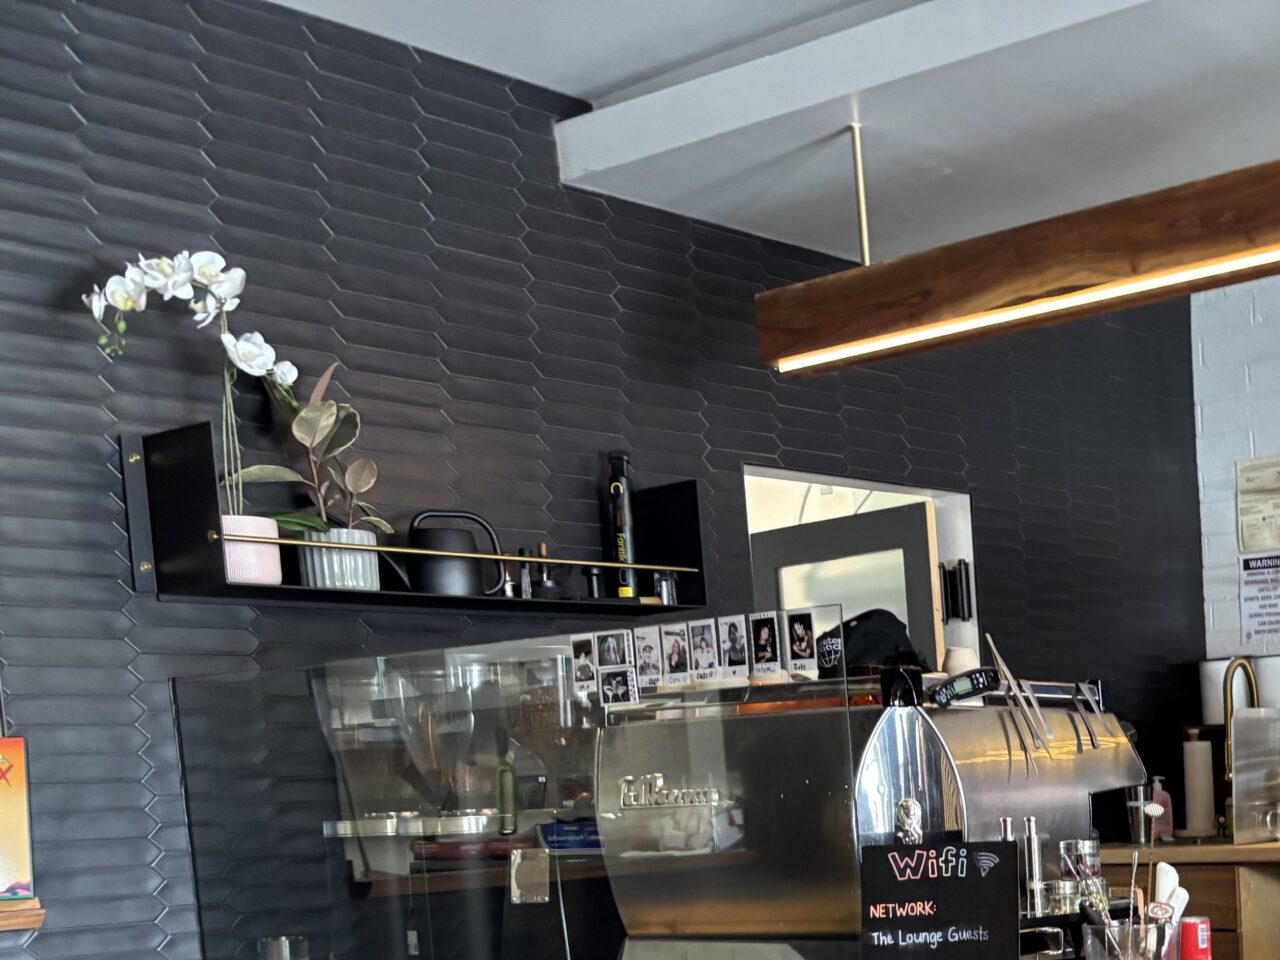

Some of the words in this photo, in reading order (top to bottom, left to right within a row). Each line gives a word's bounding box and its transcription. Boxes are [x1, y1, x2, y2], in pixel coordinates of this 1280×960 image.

[887, 845, 968, 881] Wifi
[869, 900, 937, 919] NETWORK:
[872, 931, 895, 946] The
[898, 929, 944, 949] Lounge
[947, 925, 989, 943] Guests
